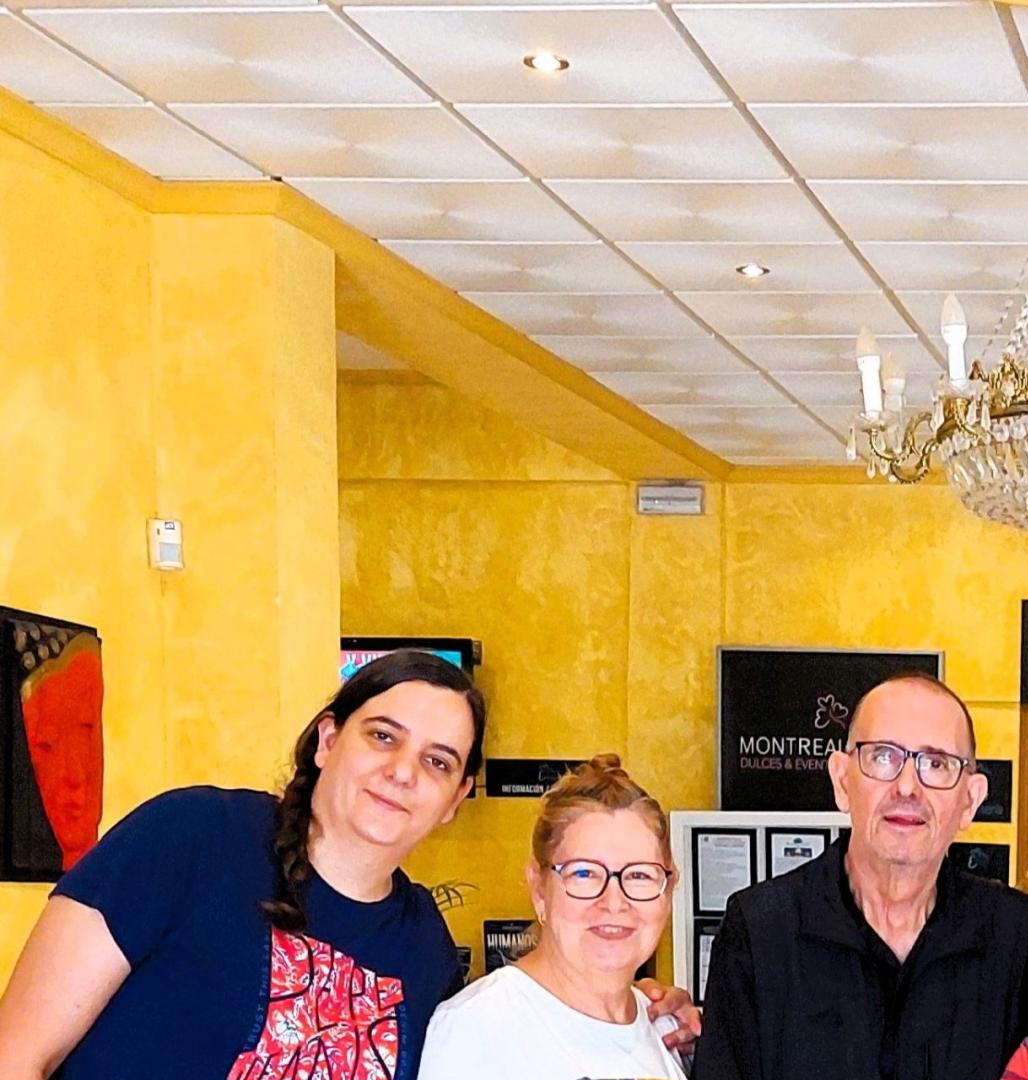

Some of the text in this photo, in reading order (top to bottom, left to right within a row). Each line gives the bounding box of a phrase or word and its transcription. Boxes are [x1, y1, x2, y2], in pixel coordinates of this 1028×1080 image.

[740, 736, 842, 756] MONTREAL
[740, 757, 828, 770] DULCES & EVEN
